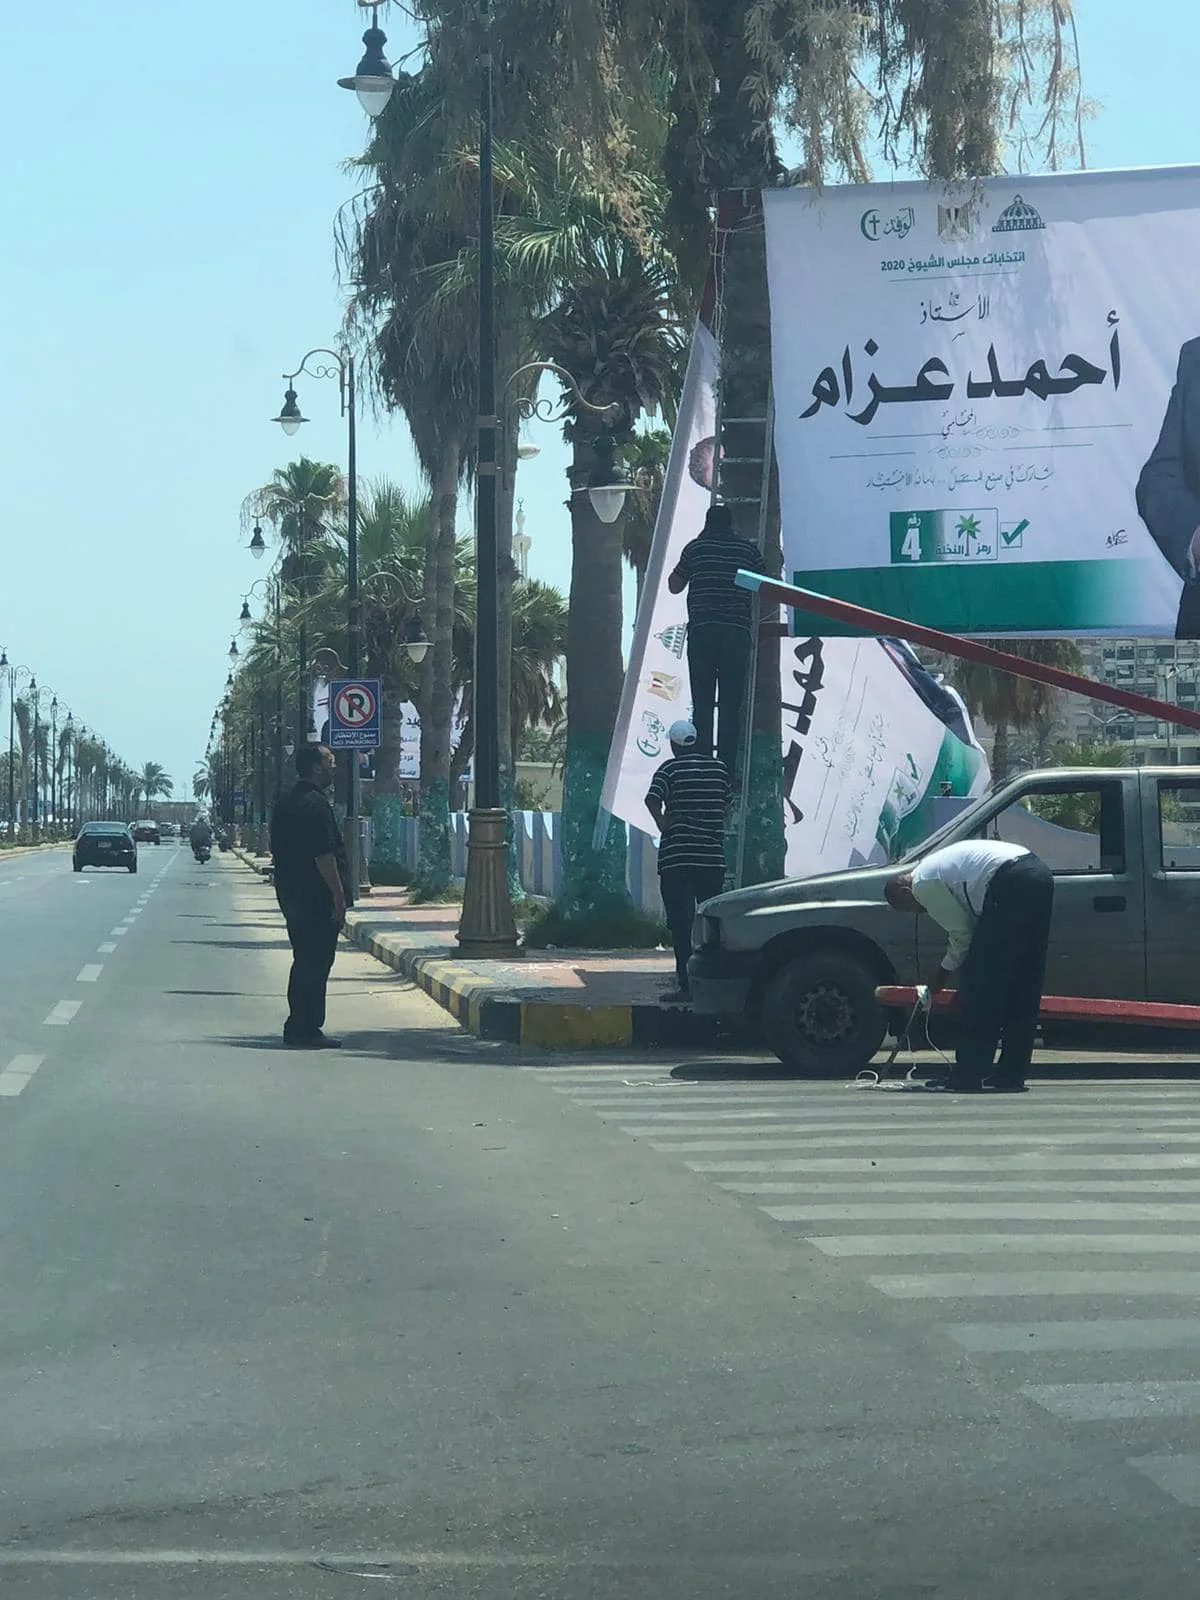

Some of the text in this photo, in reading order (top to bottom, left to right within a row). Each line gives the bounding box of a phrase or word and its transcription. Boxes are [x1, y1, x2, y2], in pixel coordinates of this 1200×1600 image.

[881, 251, 1025, 272] انتخابات مجلس الشيوخ 2020
[798, 310, 1121, 425] أحمد عزام
[901, 528, 921, 560] 4
[936, 542, 991, 555] رمز النخلة
[781, 637, 825, 735] حمد
[345, 738, 377, 746] PARKING
